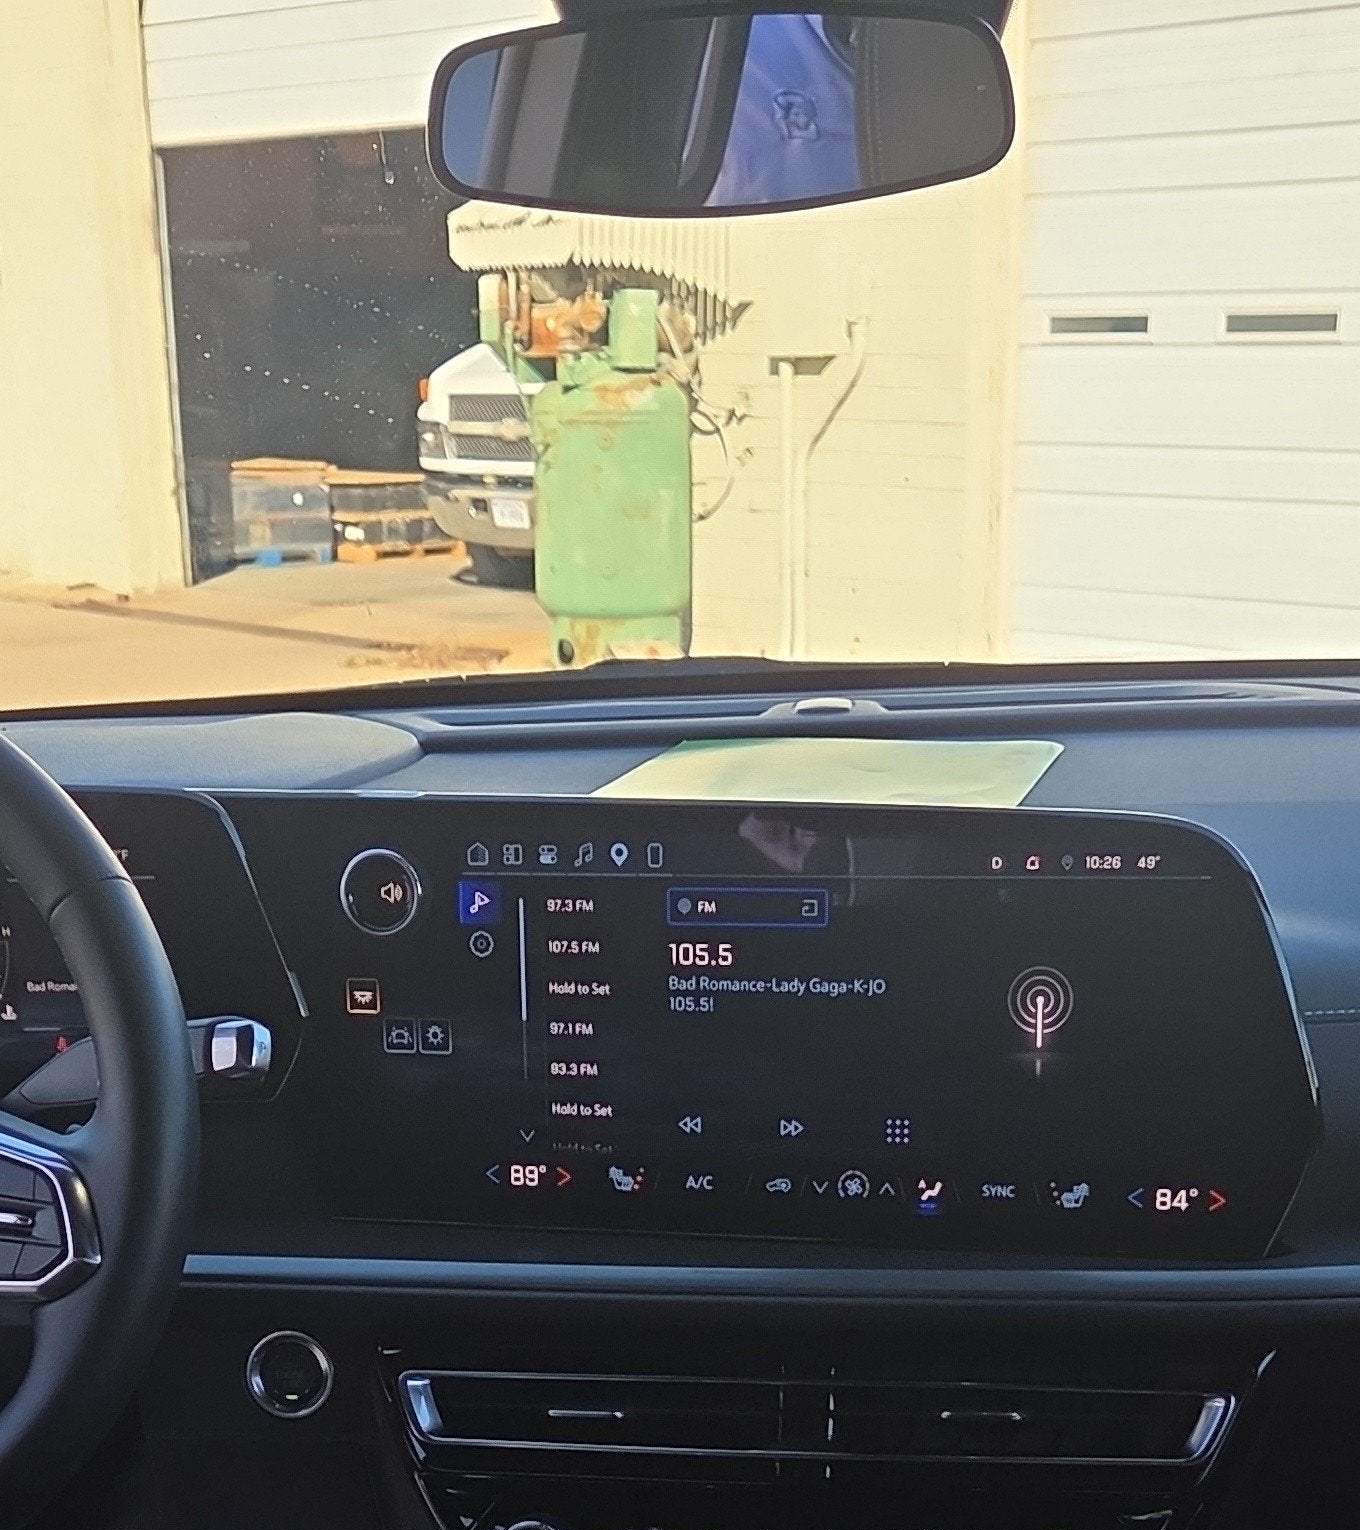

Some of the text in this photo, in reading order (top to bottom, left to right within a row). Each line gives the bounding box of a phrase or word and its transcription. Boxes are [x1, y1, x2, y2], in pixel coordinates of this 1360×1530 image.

[1085, 855, 1122, 870] 10:26
[1137, 855, 1161, 870] 49°
[546, 899, 594, 913] 97.3 FM
[697, 901, 717, 913] FM
[548, 940, 600, 954] 107.5 FM
[668, 943, 733, 966] 105.5
[26, 980, 46, 991] Bad
[548, 981, 610, 996] Hold to Set
[668, 975, 887, 997] Bad Romance-Lady Gaga-K-JO
[549, 1021, 594, 1036] 97.1 FM
[579, 1062, 598, 1077] FM
[551, 1102, 613, 1118] Hold to Set
[685, 1174, 714, 1191] A/C
[981, 1184, 1016, 1199] SYNC
[1155, 1187, 1199, 1212] 84°
